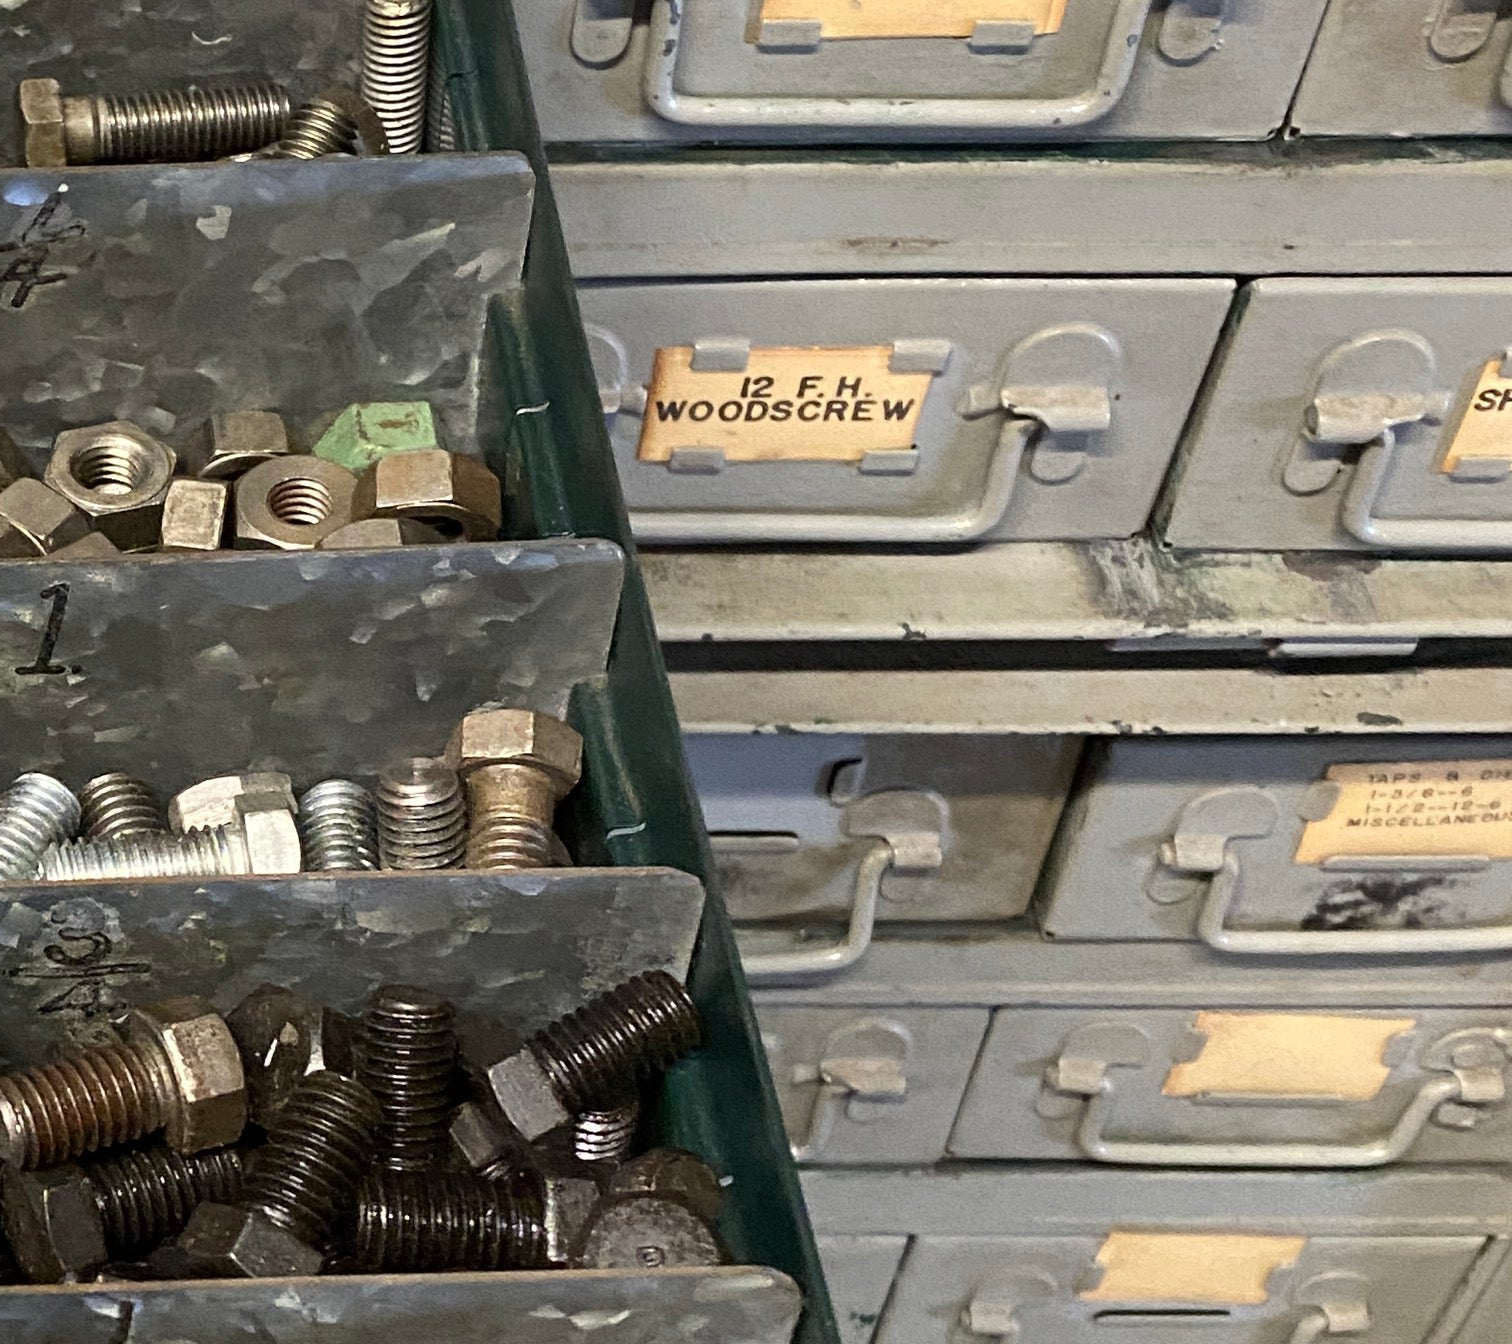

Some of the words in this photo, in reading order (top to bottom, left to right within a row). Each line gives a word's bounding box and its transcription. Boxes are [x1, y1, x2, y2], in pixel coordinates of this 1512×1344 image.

[739, 376, 776, 399] 12
[796, 376, 874, 399] F.H.
[654, 399, 916, 423] WOODSCREW
